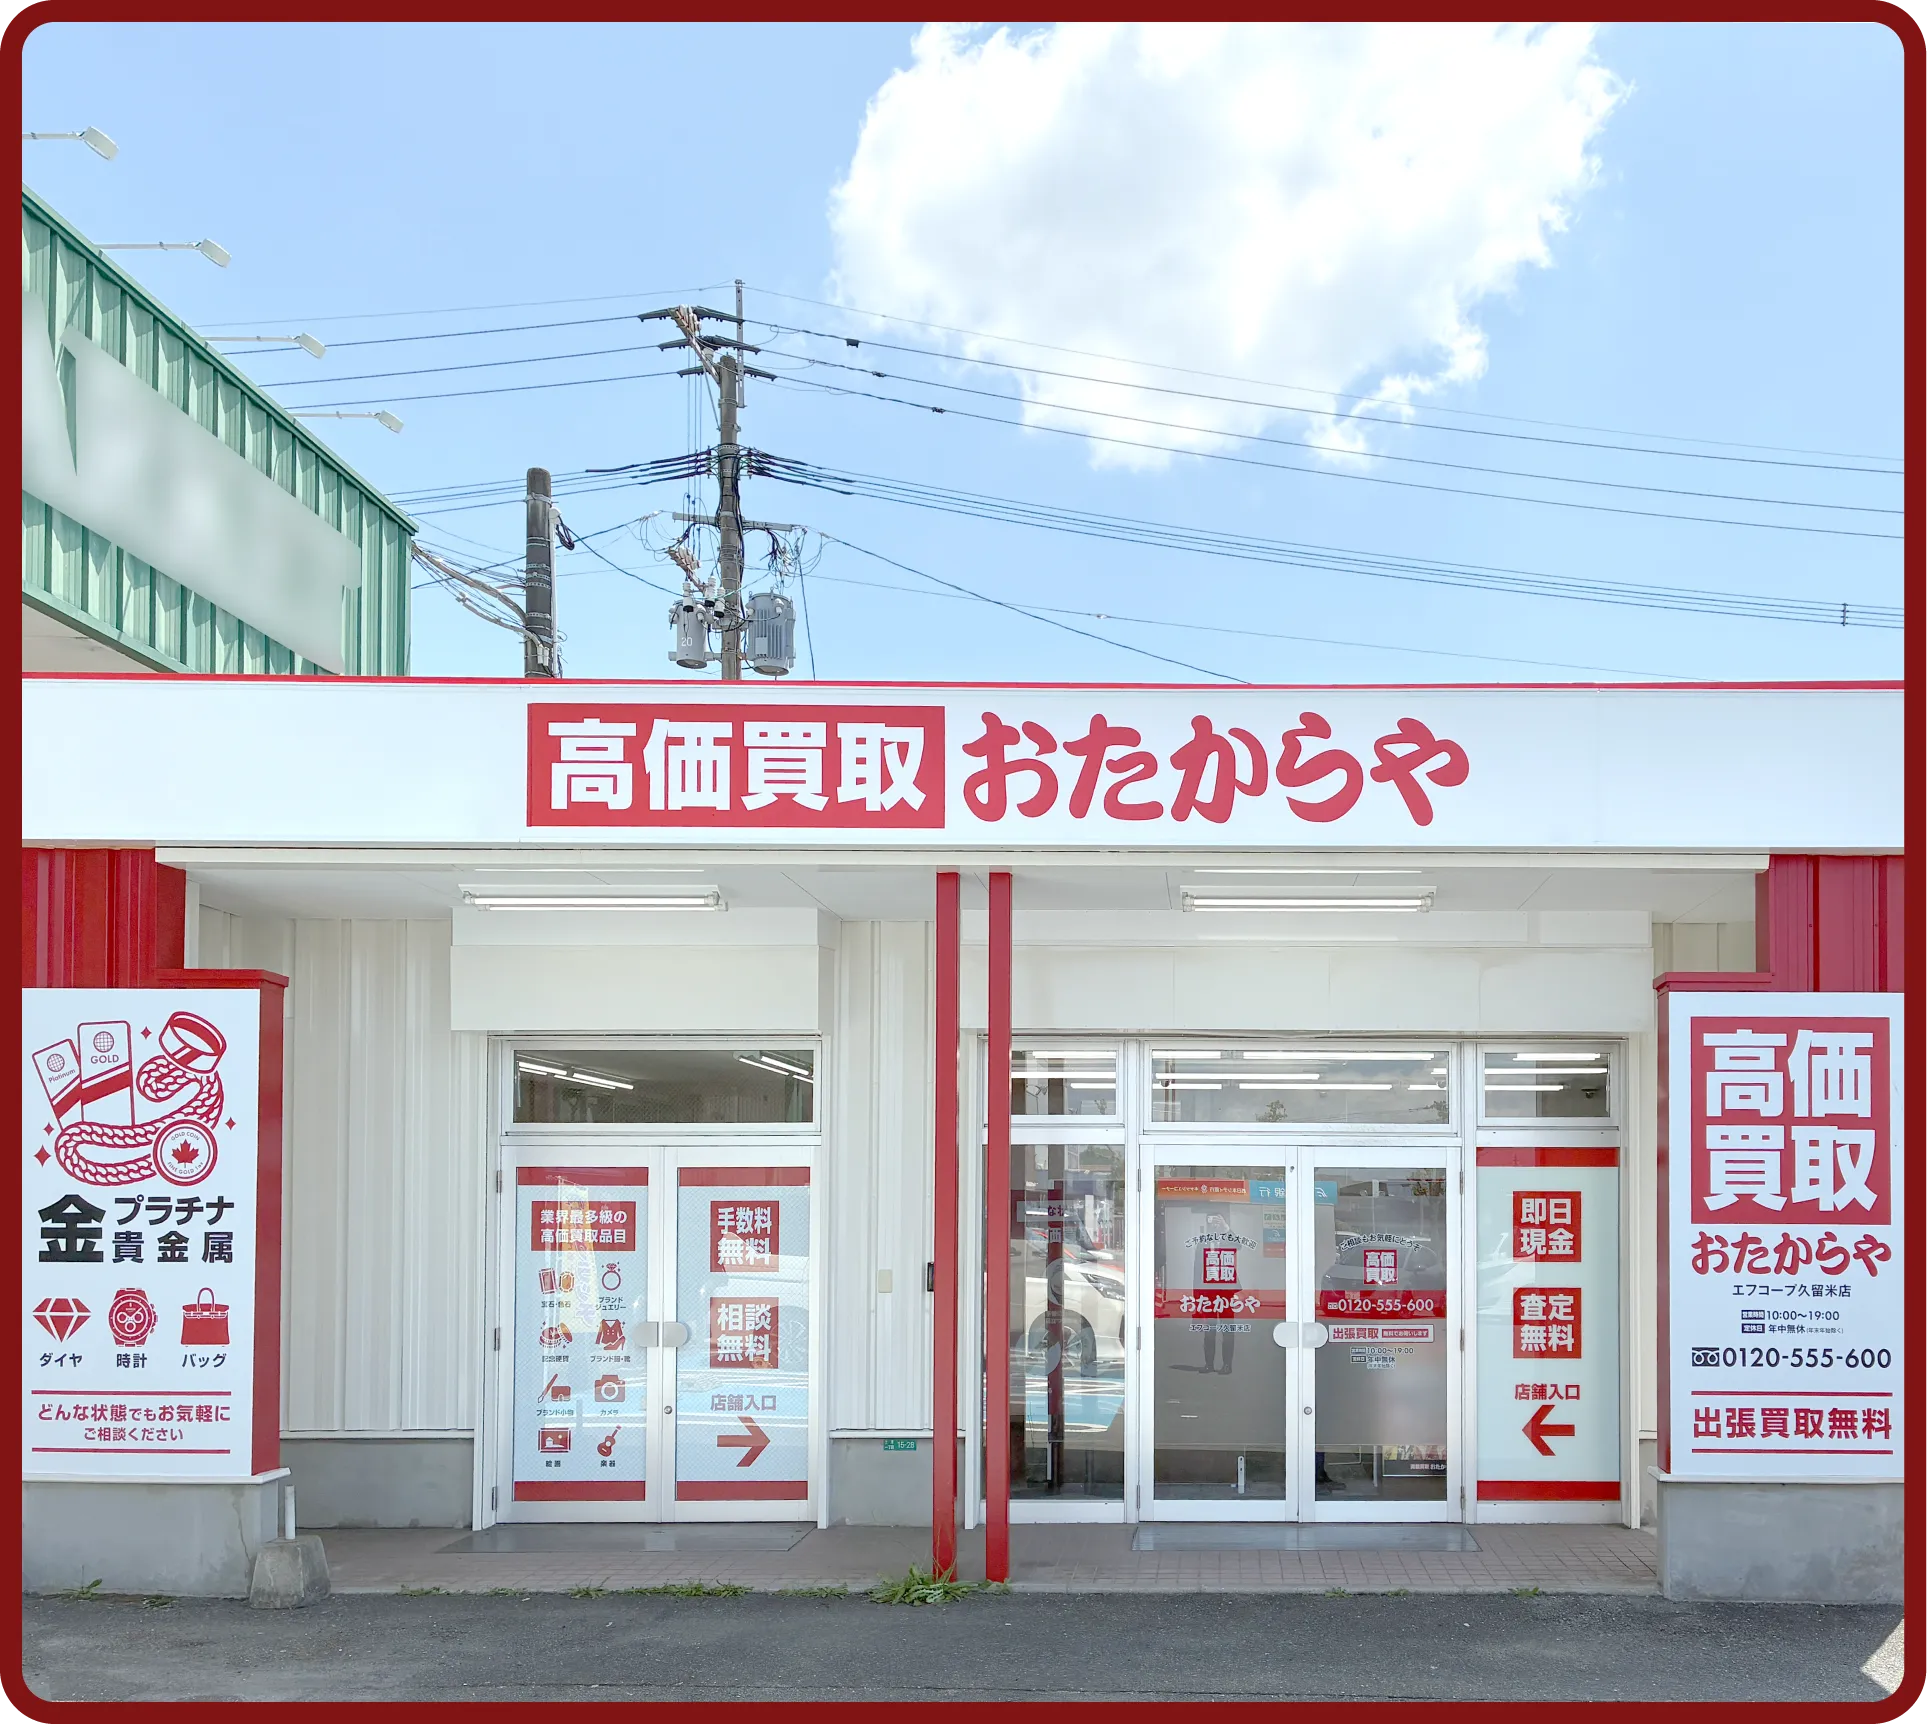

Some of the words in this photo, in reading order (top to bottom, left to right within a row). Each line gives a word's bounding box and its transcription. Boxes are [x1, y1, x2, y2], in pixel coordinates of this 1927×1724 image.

[681, 637, 693, 647] 20
[547, 717, 928, 812] 高価買取
[962, 711, 1470, 826] おたからや
[91, 1054, 119, 1064] GOLD
[48, 1069, 76, 1083] Platinum
[1703, 1029, 1875, 1119] 高価
[171, 1132, 185, 1140] GOLD
[186, 1131, 200, 1140] COIN
[1703, 1125, 1878, 1213] 買取
[114, 1194, 235, 1225] プラチナ
[540, 1209, 628, 1224] 業界最多級の
[1521, 1198, 1573, 1225] 即日
[38, 1194, 106, 1263] 金
[717, 1206, 772, 1235] 手数料
[540, 1228, 627, 1244] 高価買取品目
[1520, 1227, 1574, 1255] 現金
[112, 1230, 234, 1263] 貴金属
[717, 1238, 771, 1265] 無料
[1690, 1231, 1892, 1278] おたからや
[1205, 1250, 1235, 1266] 高価
[1365, 1251, 1396, 1267] 高価
[1205, 1266, 1235, 1282] 買取
[1365, 1268, 1397, 1282] 買取
[1179, 1295, 1261, 1314] おたからや
[1338, 1299, 1435, 1312] 0120-555-600
[1520, 1293, 1574, 1321] 査定
[717, 1303, 771, 1332] 相談
[1766, 1311, 1840, 1321] 10:00～19:00
[1333, 1328, 1379, 1340] 出張買取
[1520, 1324, 1574, 1352] 無料
[1768, 1324, 1806, 1334] 年中無休
[717, 1334, 771, 1362] 無料
[39, 1353, 83, 1368] ダイヤ
[116, 1353, 147, 1368] 時計
[182, 1353, 227, 1368] バッグ
[1722, 1347, 1892, 1369] 0120-555-600
[1514, 1383, 1581, 1401] 店舗入口
[711, 1393, 777, 1411] 店舗入口
[38, 1404, 231, 1422] どんな状態でもお気軽に
[1693, 1406, 1892, 1440] 出張買取無料
[84, 1427, 184, 1442] ご相談ください
